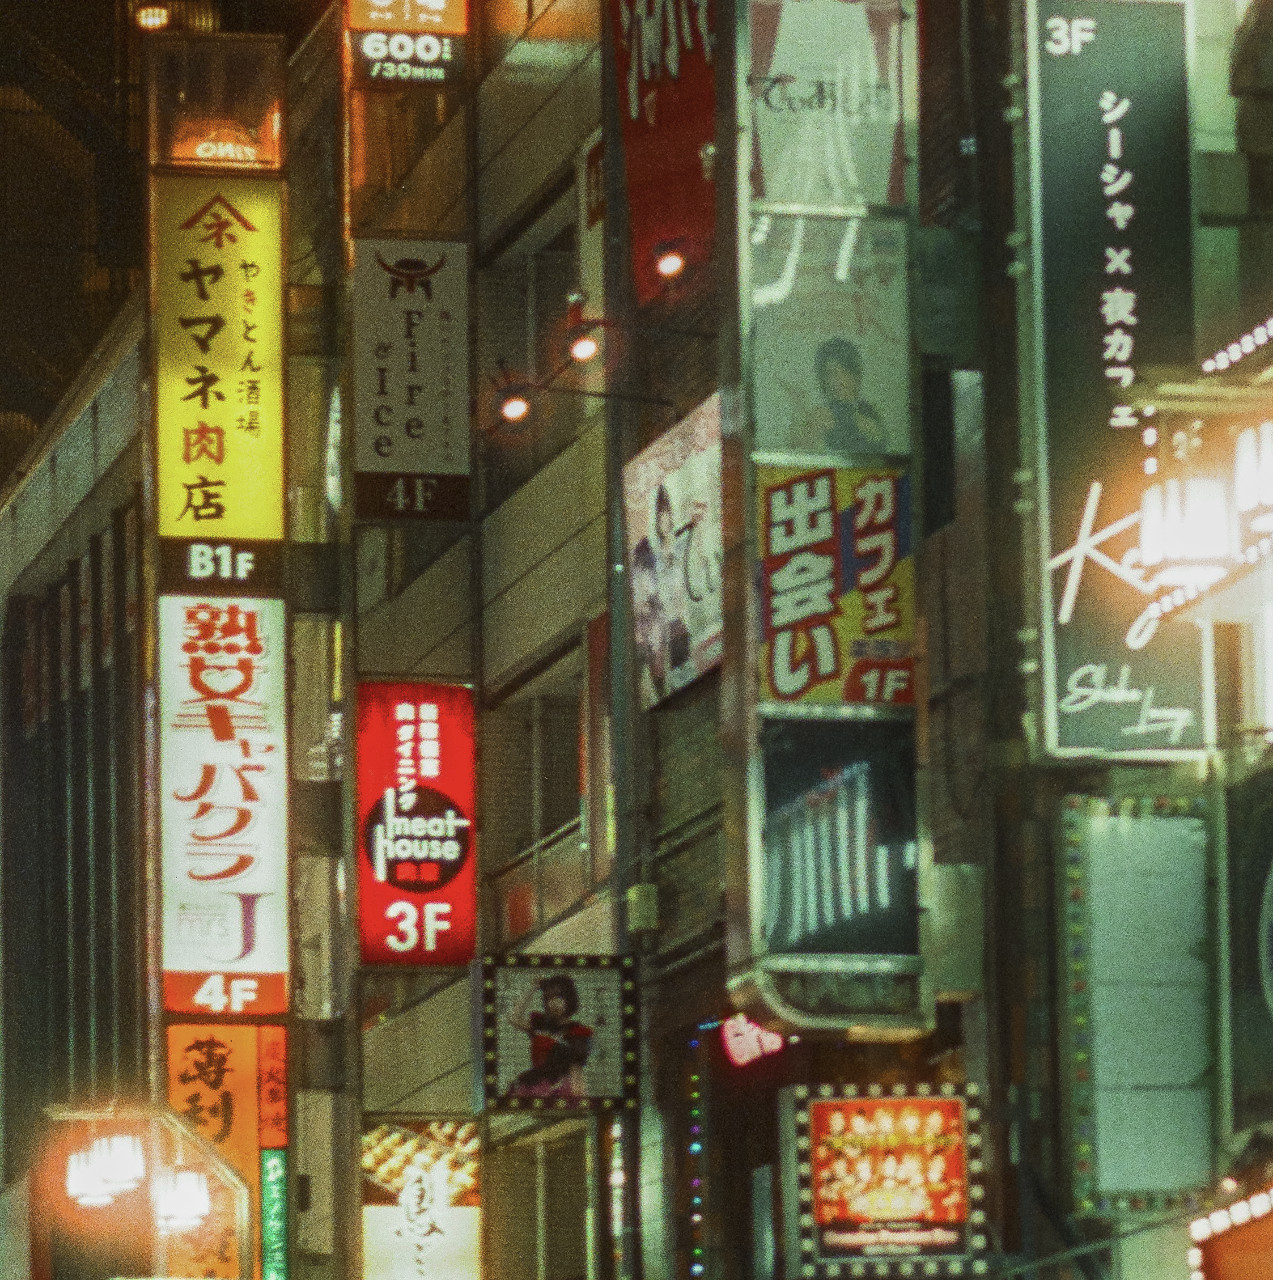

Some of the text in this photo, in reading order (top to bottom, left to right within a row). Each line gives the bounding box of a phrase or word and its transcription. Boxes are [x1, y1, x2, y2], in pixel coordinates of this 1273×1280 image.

[362, 32, 442, 63] 600
[1045, 17, 1097, 55] 3F
[179, 257, 228, 525] ヤマネ肉店
[405, 309, 425, 439] Fire
[387, 477, 437, 512] 4F
[188, 544, 254, 581] B1F
[852, 476, 898, 634] カフェ
[767, 476, 839, 697] 出会い
[859, 668, 911, 702] 1F
[374, 824, 462, 883] house
[385, 900, 452, 952] 3F
[194, 974, 258, 1013] 4F
